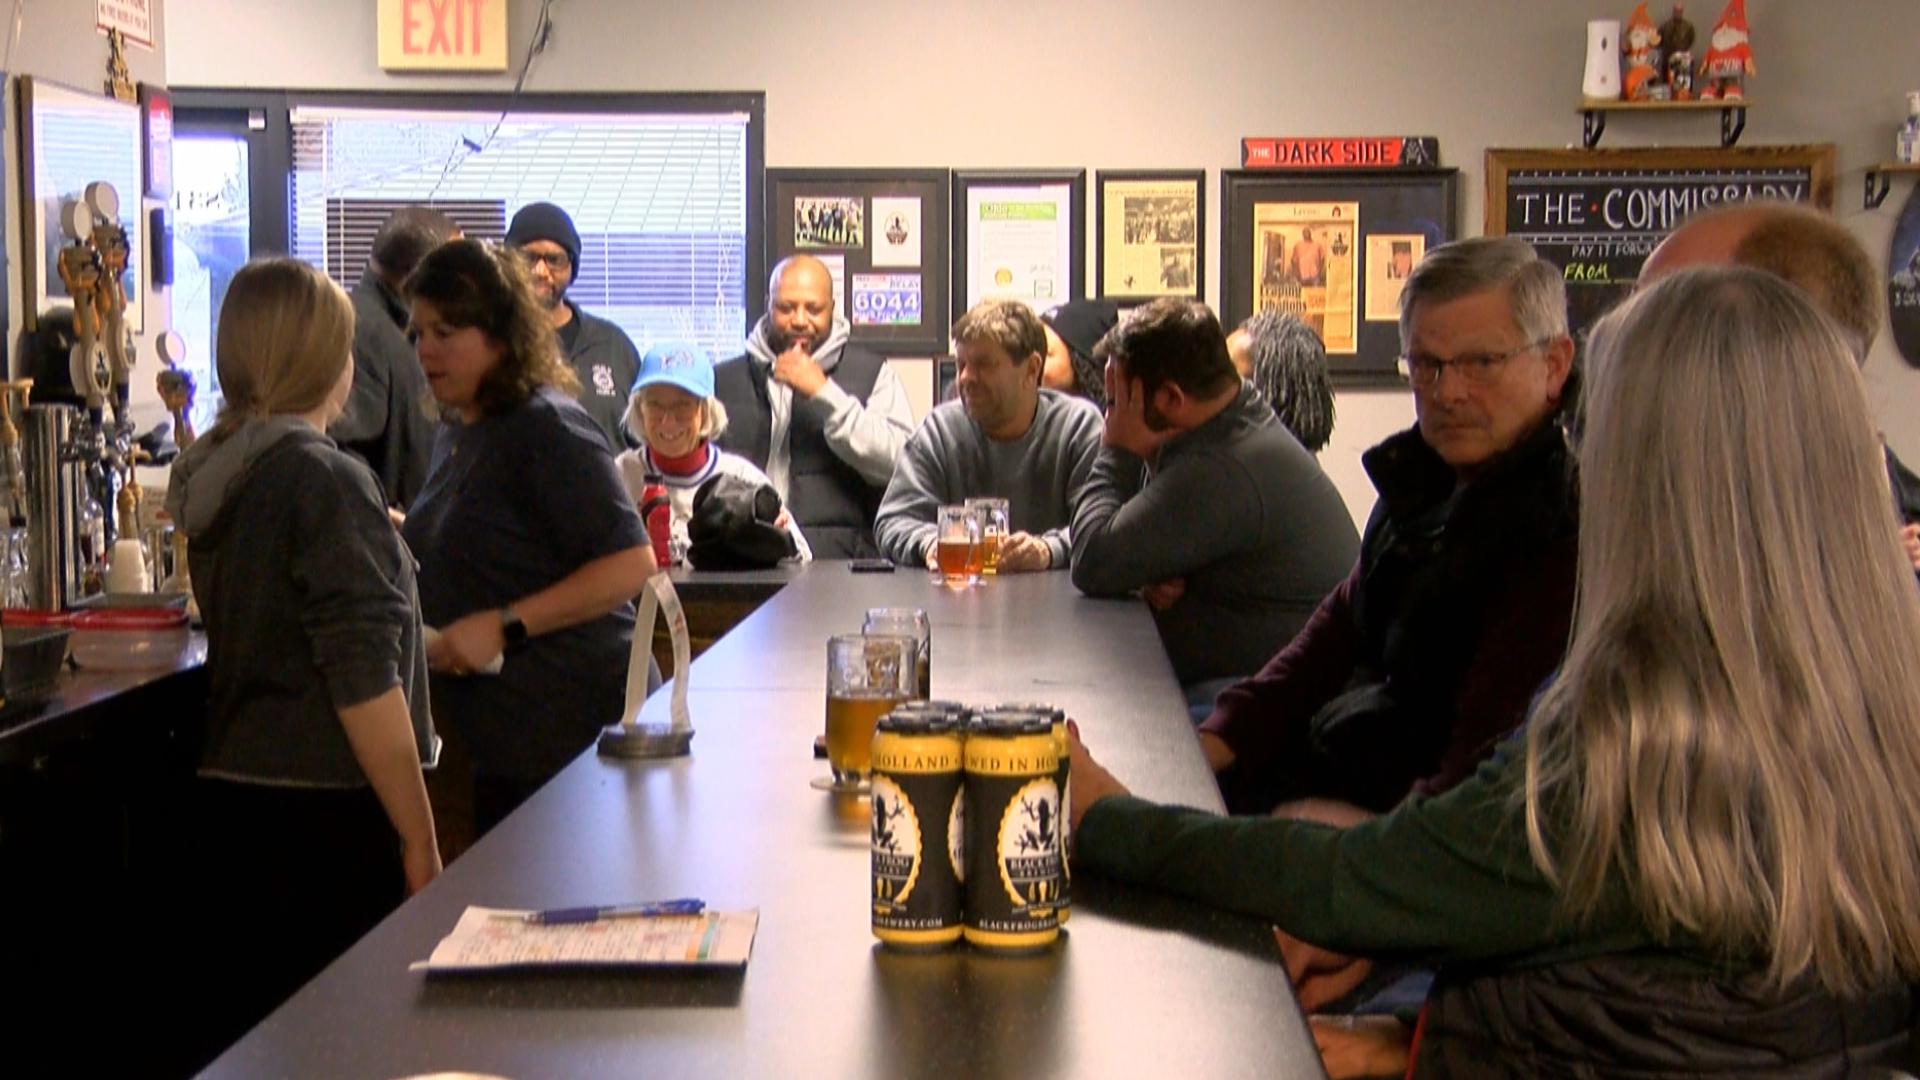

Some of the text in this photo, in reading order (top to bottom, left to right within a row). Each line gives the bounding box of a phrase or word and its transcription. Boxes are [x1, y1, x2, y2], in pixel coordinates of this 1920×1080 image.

[402, 0, 487, 55] EXIT
[1252, 141, 1393, 164] THE DARK SIDE
[1516, 192, 1586, 225] THE
[1571, 241, 1654, 258] PAY IT FORWA
[1563, 262, 1609, 280] FROM
[855, 292, 918, 312] 6044
[1009, 757, 1028, 771] IN
